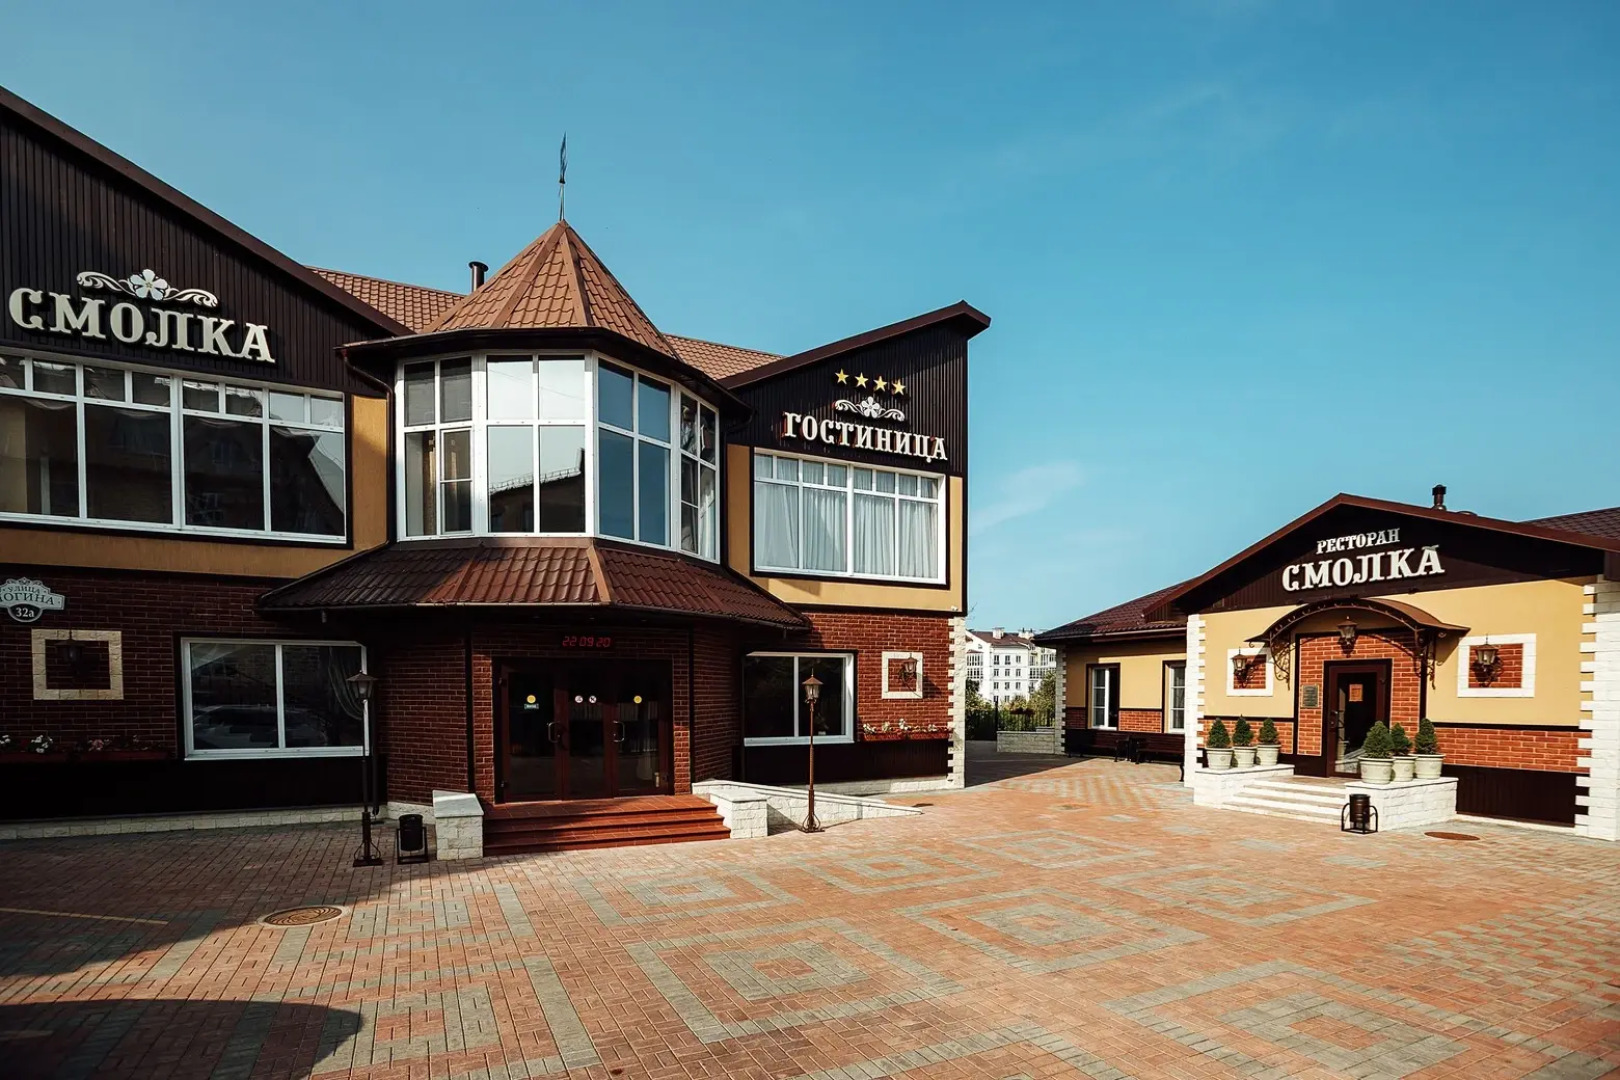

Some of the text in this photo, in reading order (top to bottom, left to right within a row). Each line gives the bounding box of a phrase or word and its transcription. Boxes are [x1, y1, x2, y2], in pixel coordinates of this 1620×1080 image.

[8, 287, 276, 363] СМОЛКА
[783, 411, 948, 463] ГОСТИНИЦА
[1316, 528, 1400, 554] РЕСТОРАН
[1282, 545, 1445, 591] СМОЛКА
